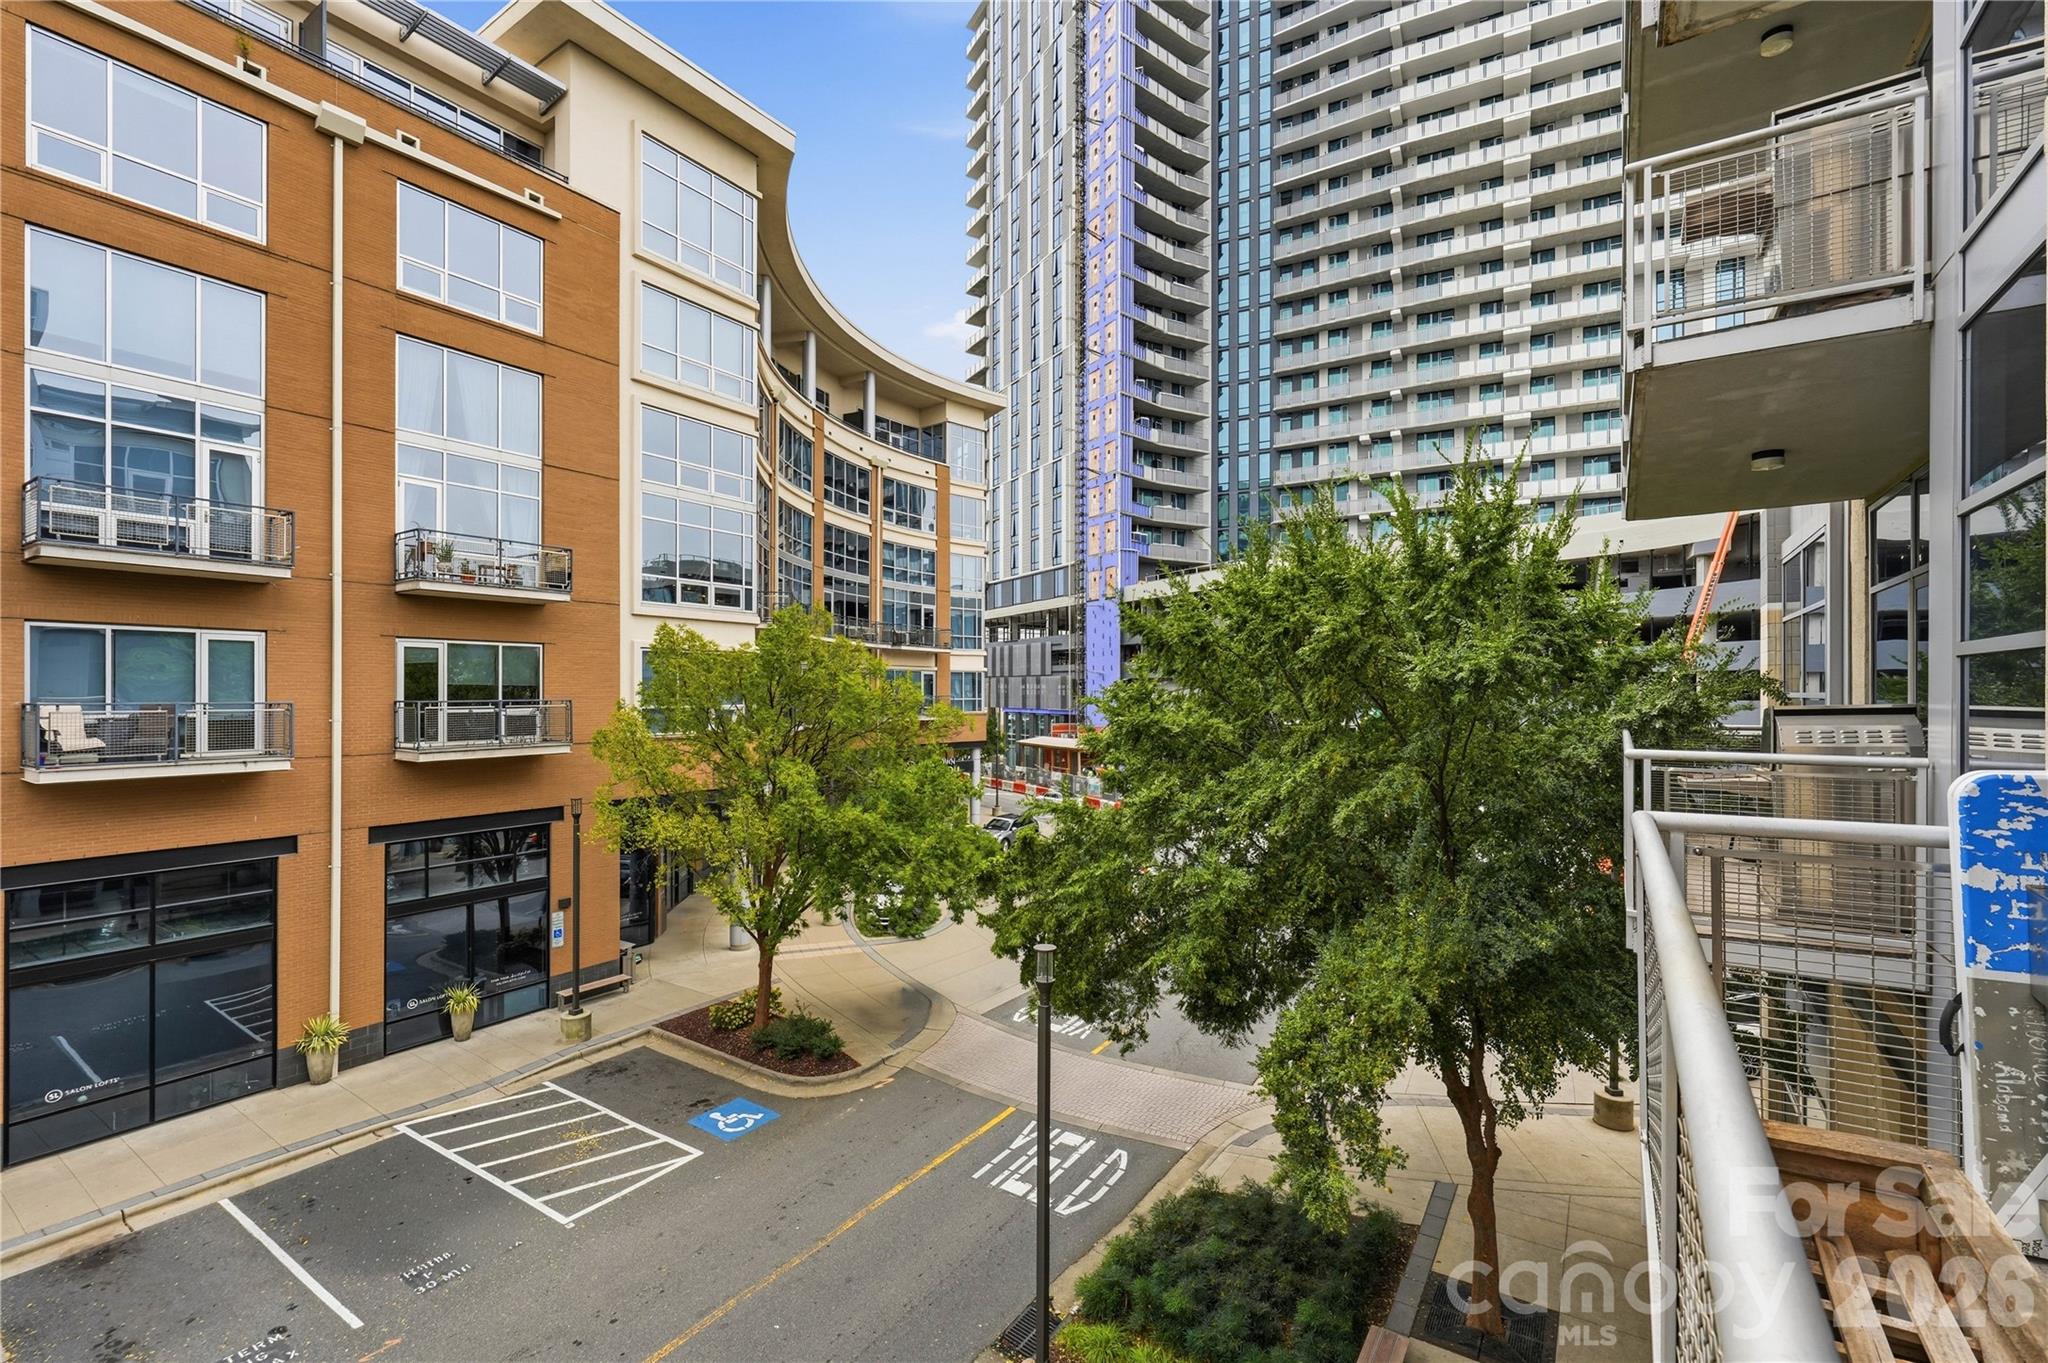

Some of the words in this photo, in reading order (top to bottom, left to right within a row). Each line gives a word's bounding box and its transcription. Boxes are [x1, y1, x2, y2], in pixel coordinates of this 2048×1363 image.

[64, 1084, 93, 1096] SALON
[94, 1077, 118, 1088] LOFTS
[971, 1120, 1128, 1216] YIELD
[412, 1280, 437, 1295] 30
[222, 1333, 286, 1363] TERM
